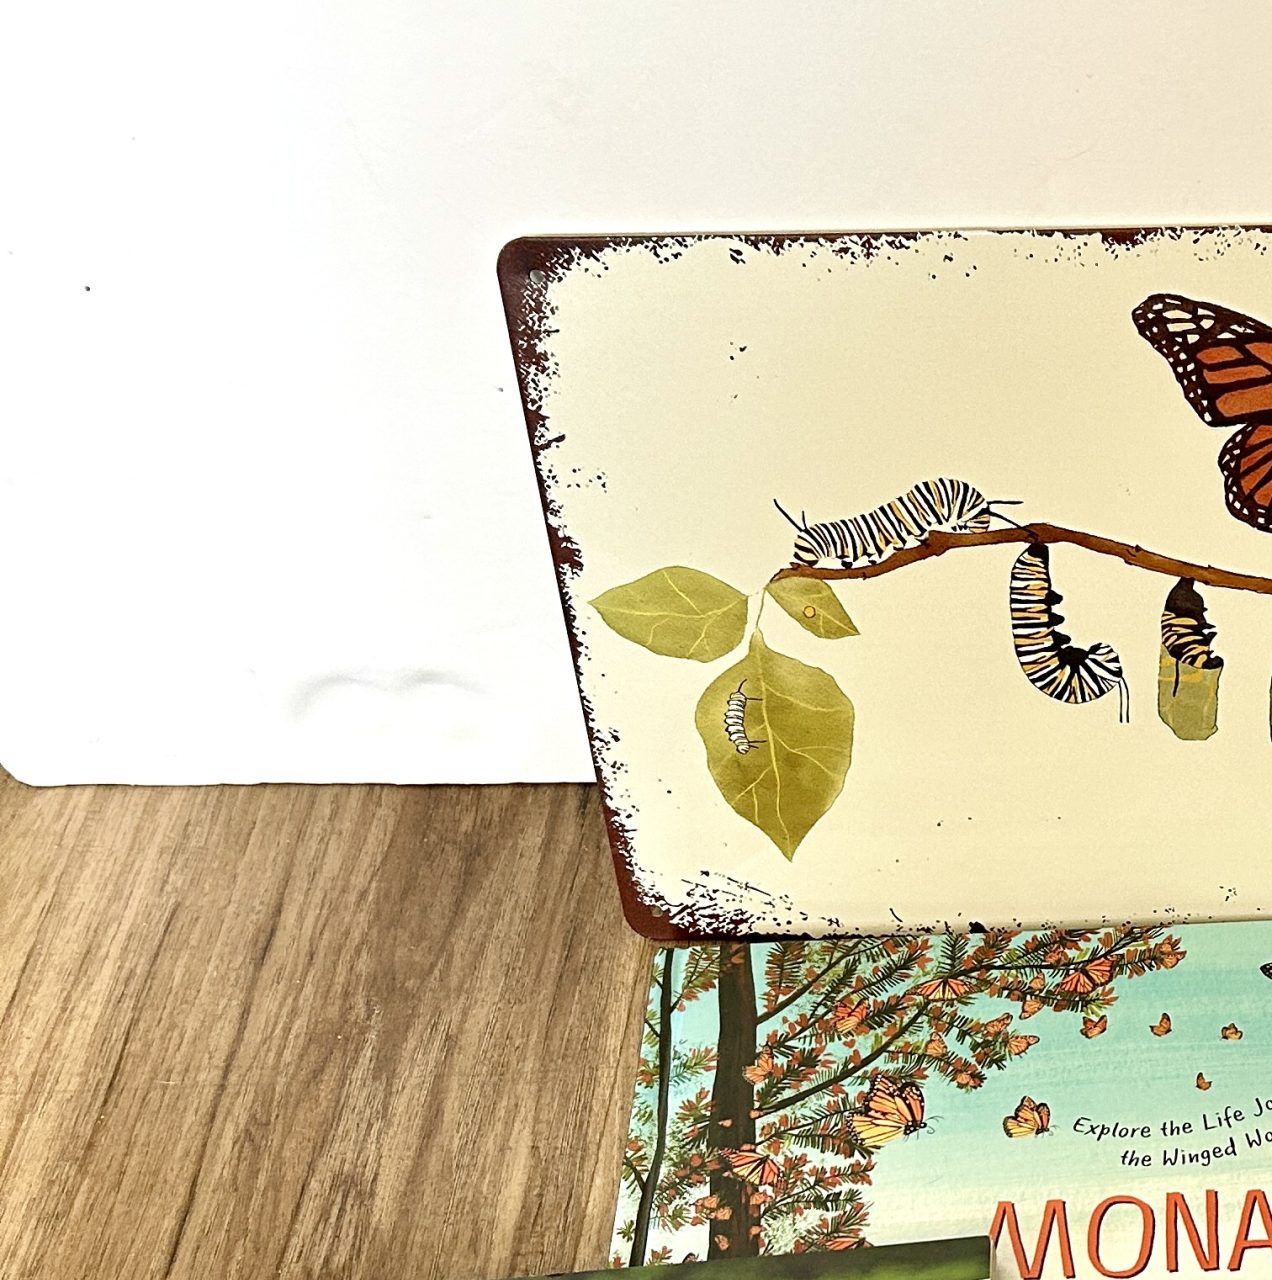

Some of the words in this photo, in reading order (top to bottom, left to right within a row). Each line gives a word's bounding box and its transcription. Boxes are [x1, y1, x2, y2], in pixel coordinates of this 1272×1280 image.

[1072, 1116, 1153, 1141] Explore
[1160, 1116, 1194, 1137] the
[1202, 1106, 1246, 1132] Life
[1121, 1148, 1153, 1167] the
[1161, 1140, 1238, 1167] Winged
